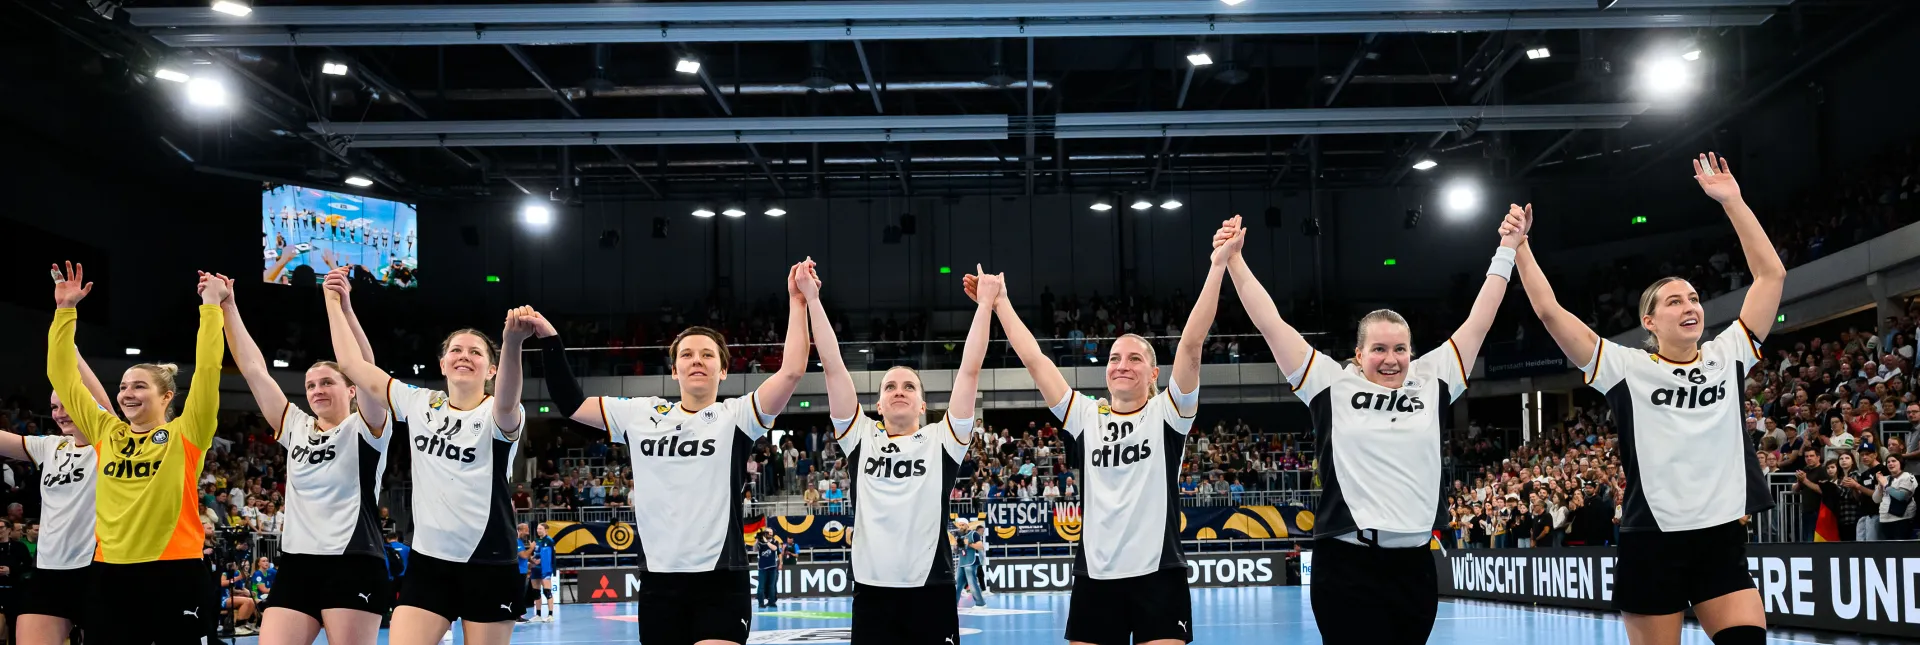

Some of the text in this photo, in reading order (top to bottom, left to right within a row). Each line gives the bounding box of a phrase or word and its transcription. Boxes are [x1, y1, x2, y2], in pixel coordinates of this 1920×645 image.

[1525, 357, 1564, 369] Heidelberg
[1350, 390, 1425, 412] atlas
[1651, 380, 1727, 409] atlas
[1103, 421, 1134, 442] 30
[414, 435, 476, 463] atlas
[640, 435, 716, 457] atlas
[1091, 439, 1152, 467] atlas
[43, 468, 85, 488] atas
[103, 459, 163, 479] atlas
[864, 456, 927, 478] atlas
[987, 502, 1048, 525] KETSCH
[983, 557, 1273, 589] MITSU OTORS
[1451, 552, 1527, 595] WÜNSCHT
[1532, 556, 1594, 600] IHNEN
